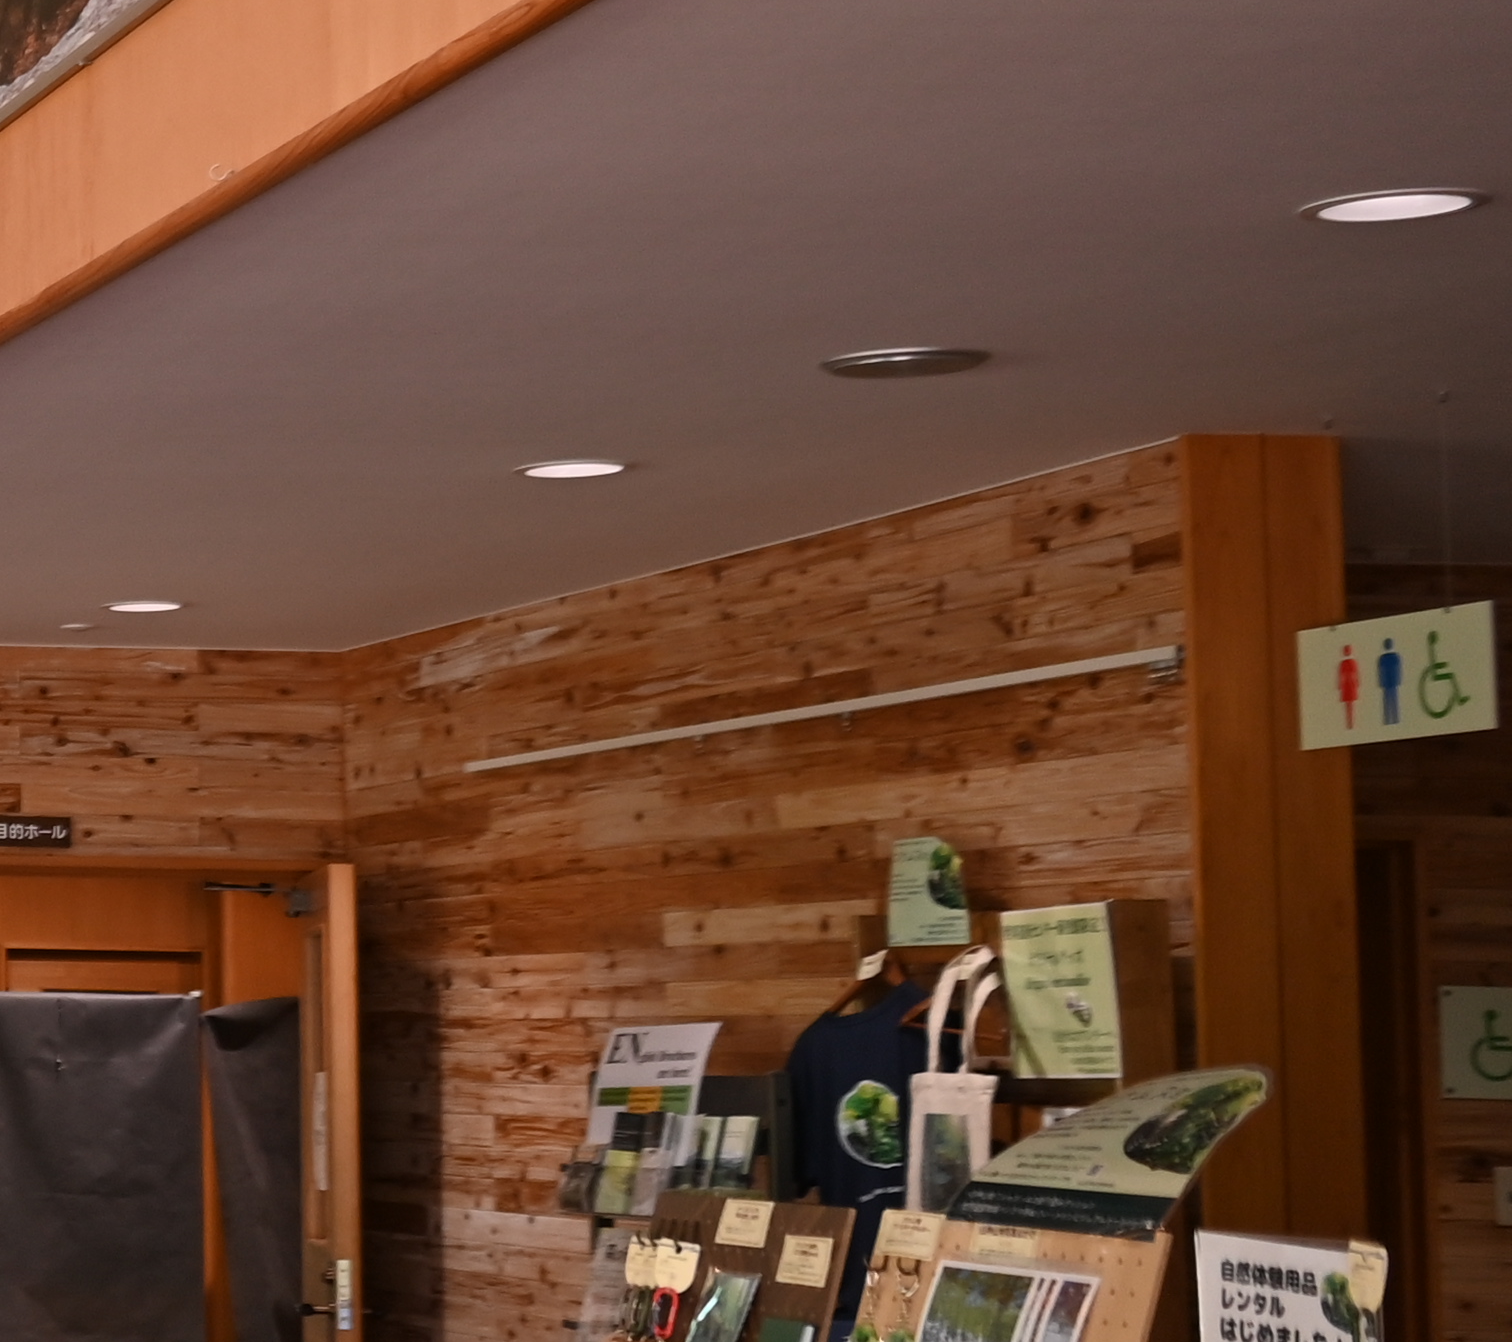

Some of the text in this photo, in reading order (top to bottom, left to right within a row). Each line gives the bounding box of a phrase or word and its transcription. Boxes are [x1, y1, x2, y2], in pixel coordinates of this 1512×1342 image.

[1221, 1259, 1318, 1298] 自然体験用品
[1221, 1288, 1286, 1320] レンタル
